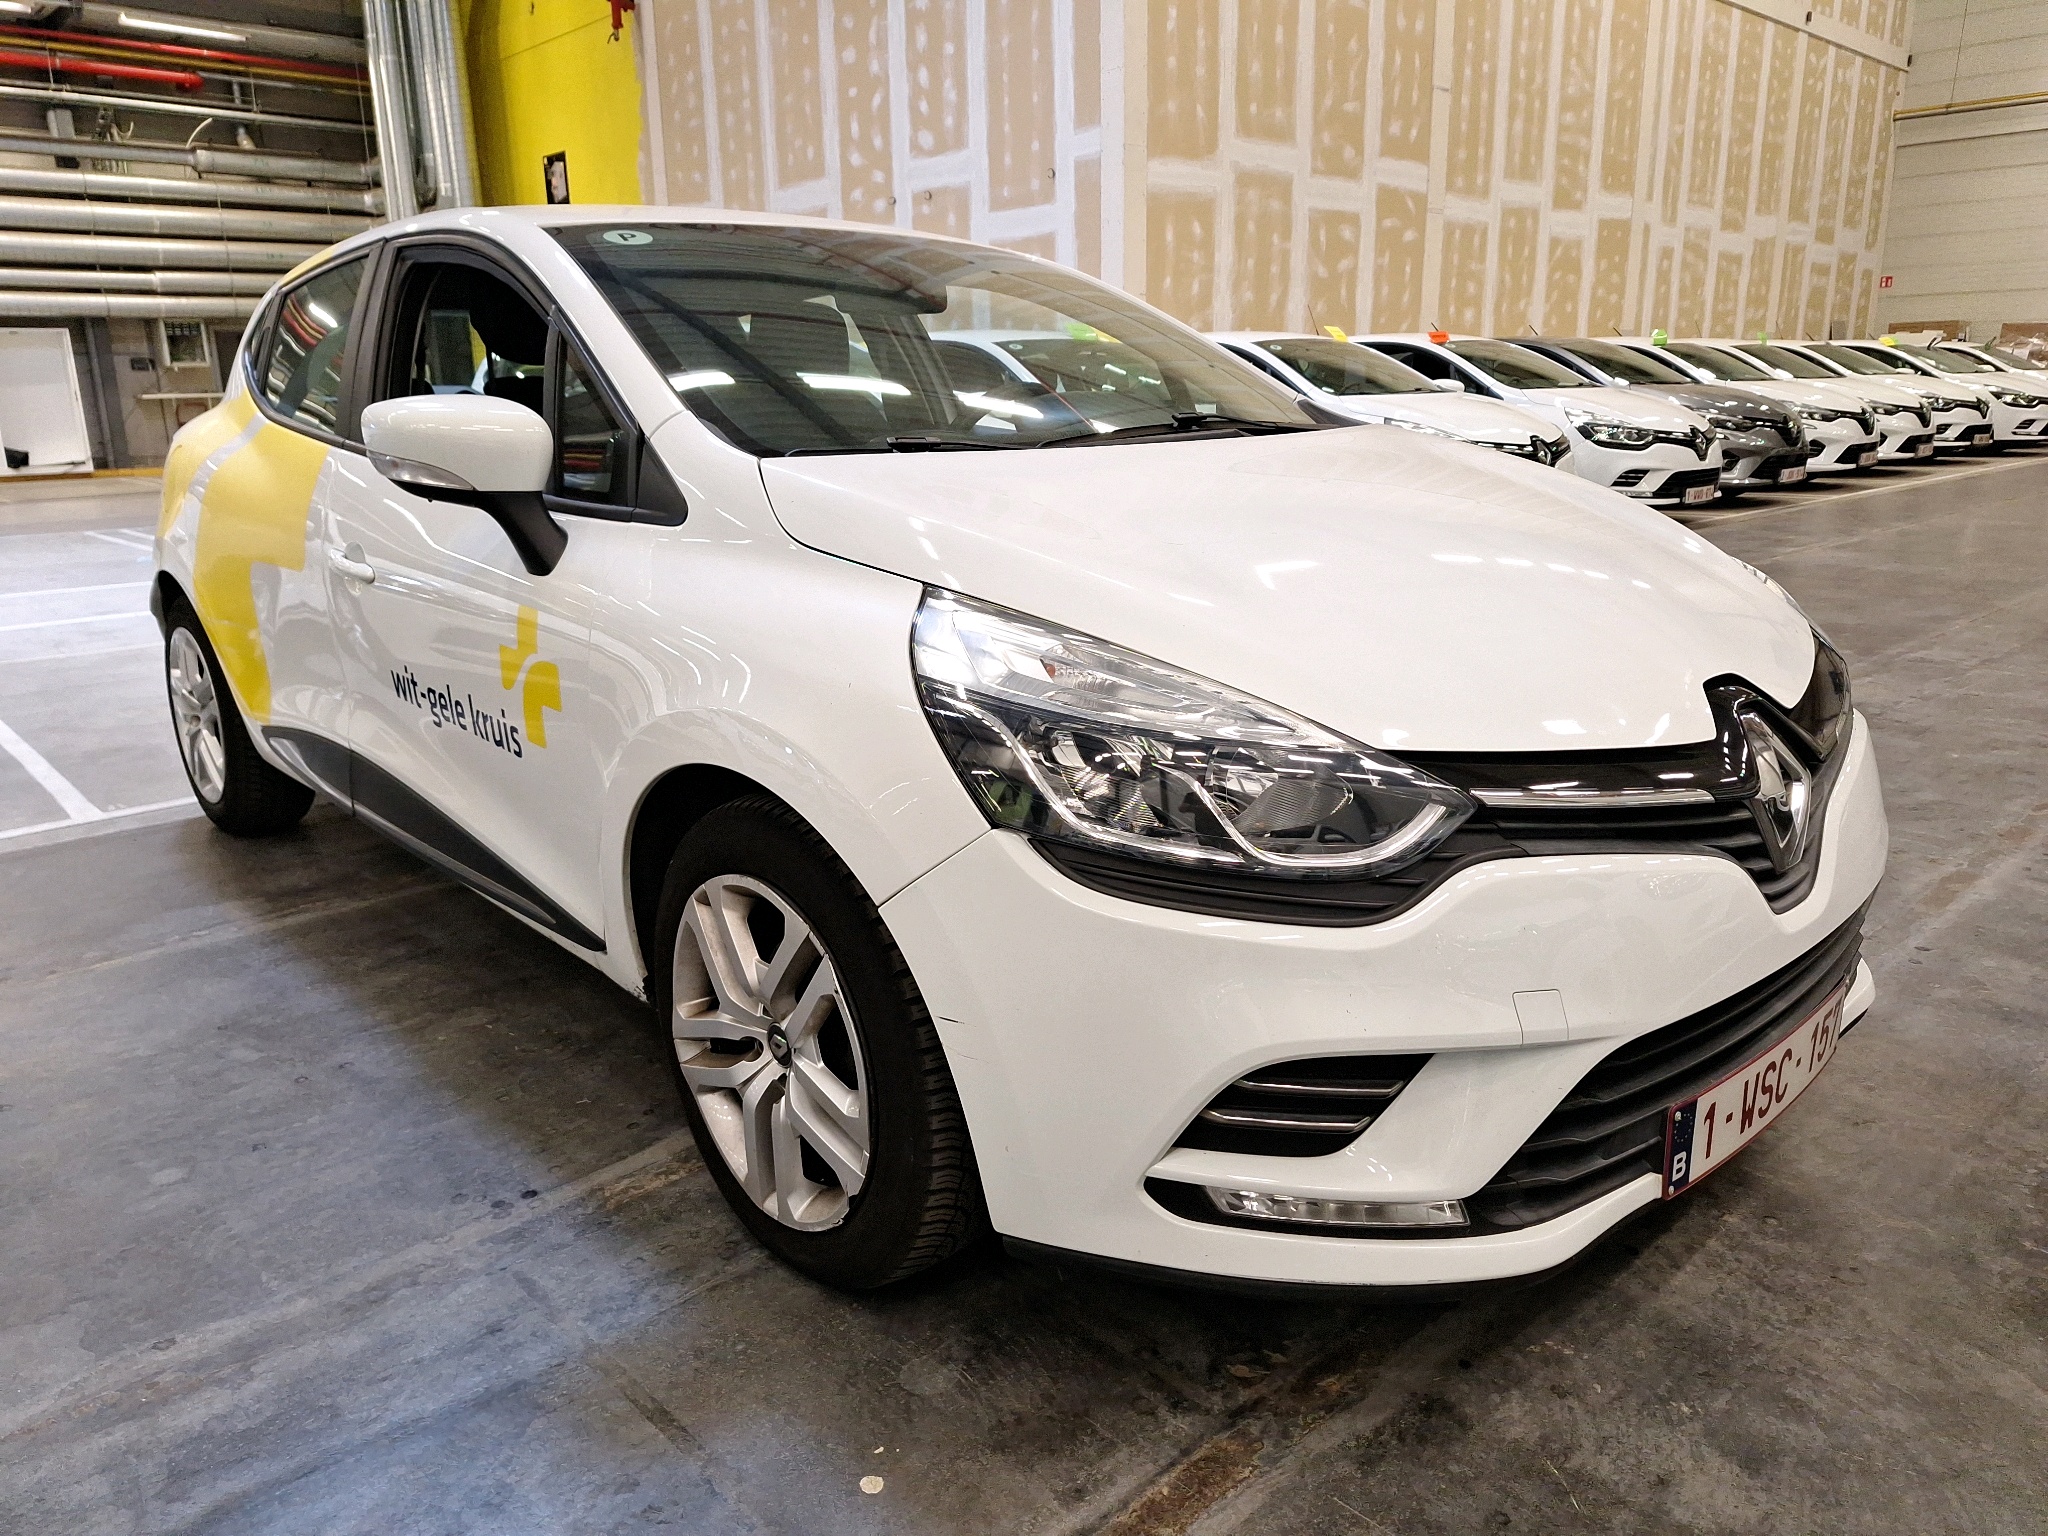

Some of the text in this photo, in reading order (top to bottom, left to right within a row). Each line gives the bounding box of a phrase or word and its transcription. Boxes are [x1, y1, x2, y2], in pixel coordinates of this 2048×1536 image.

[617, 232, 637, 242] P
[390, 665, 523, 759] wit-gele kruis
[1671, 1151, 1687, 1183] B
